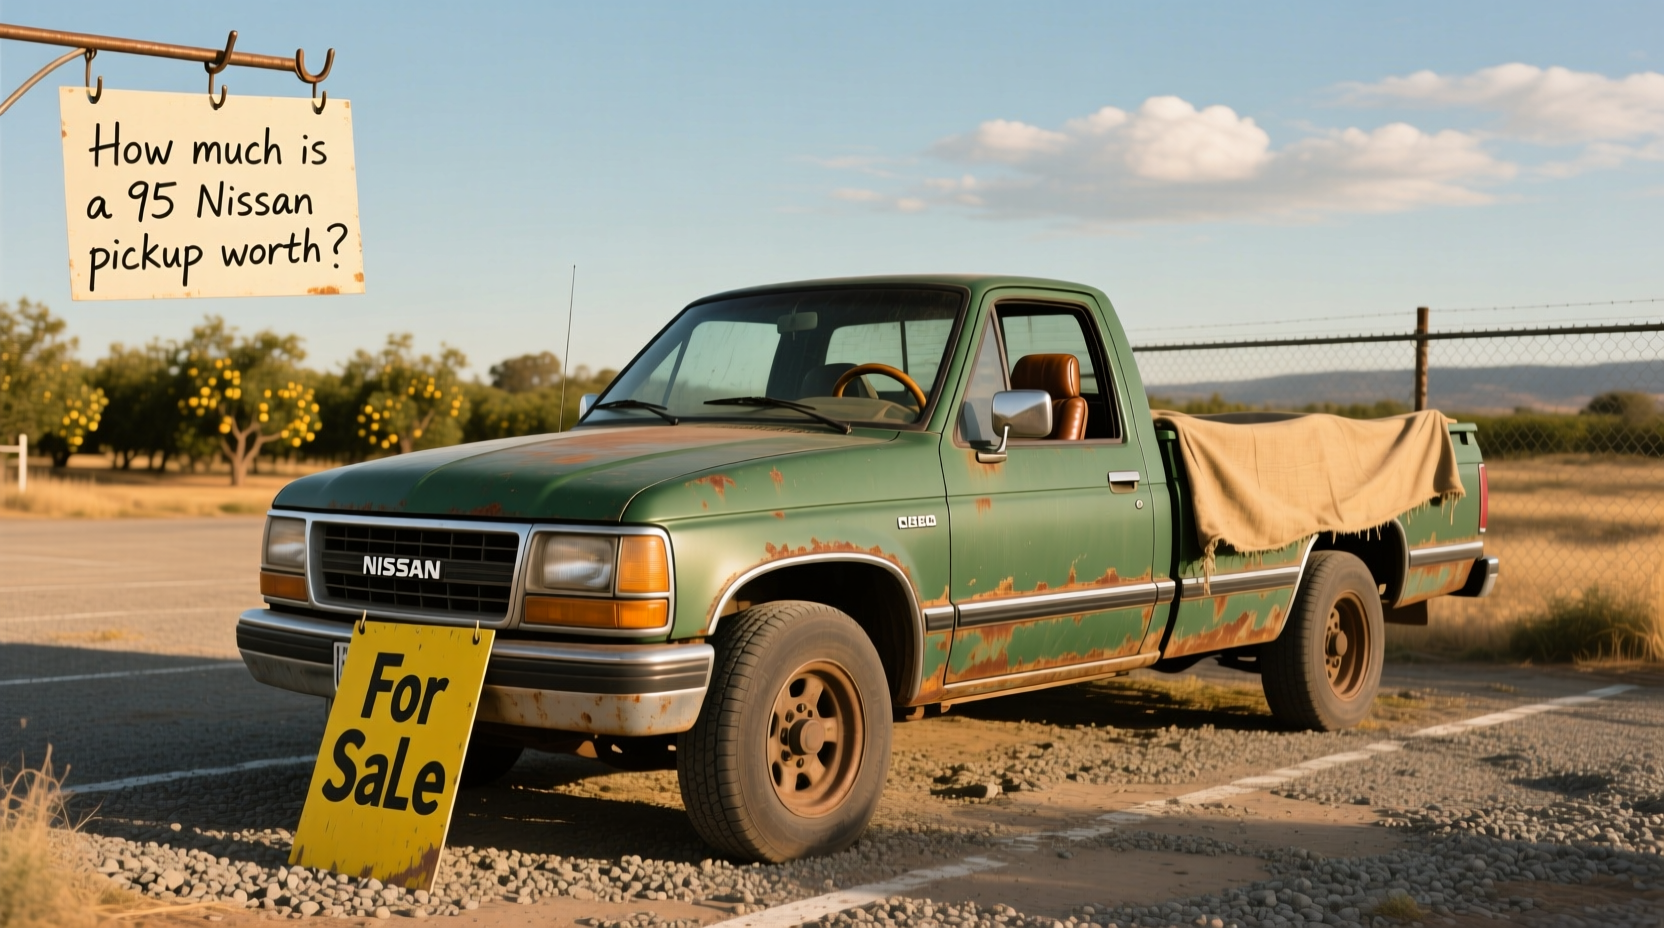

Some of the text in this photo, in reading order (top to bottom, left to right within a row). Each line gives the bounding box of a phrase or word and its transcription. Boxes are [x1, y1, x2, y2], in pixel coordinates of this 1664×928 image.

[88, 121, 327, 168] How much is
[86, 180, 314, 223] a 95 Nissan
[89, 222, 348, 292] pickup worth?
[362, 555, 441, 580] NISSAN
[360, 651, 450, 726] For
